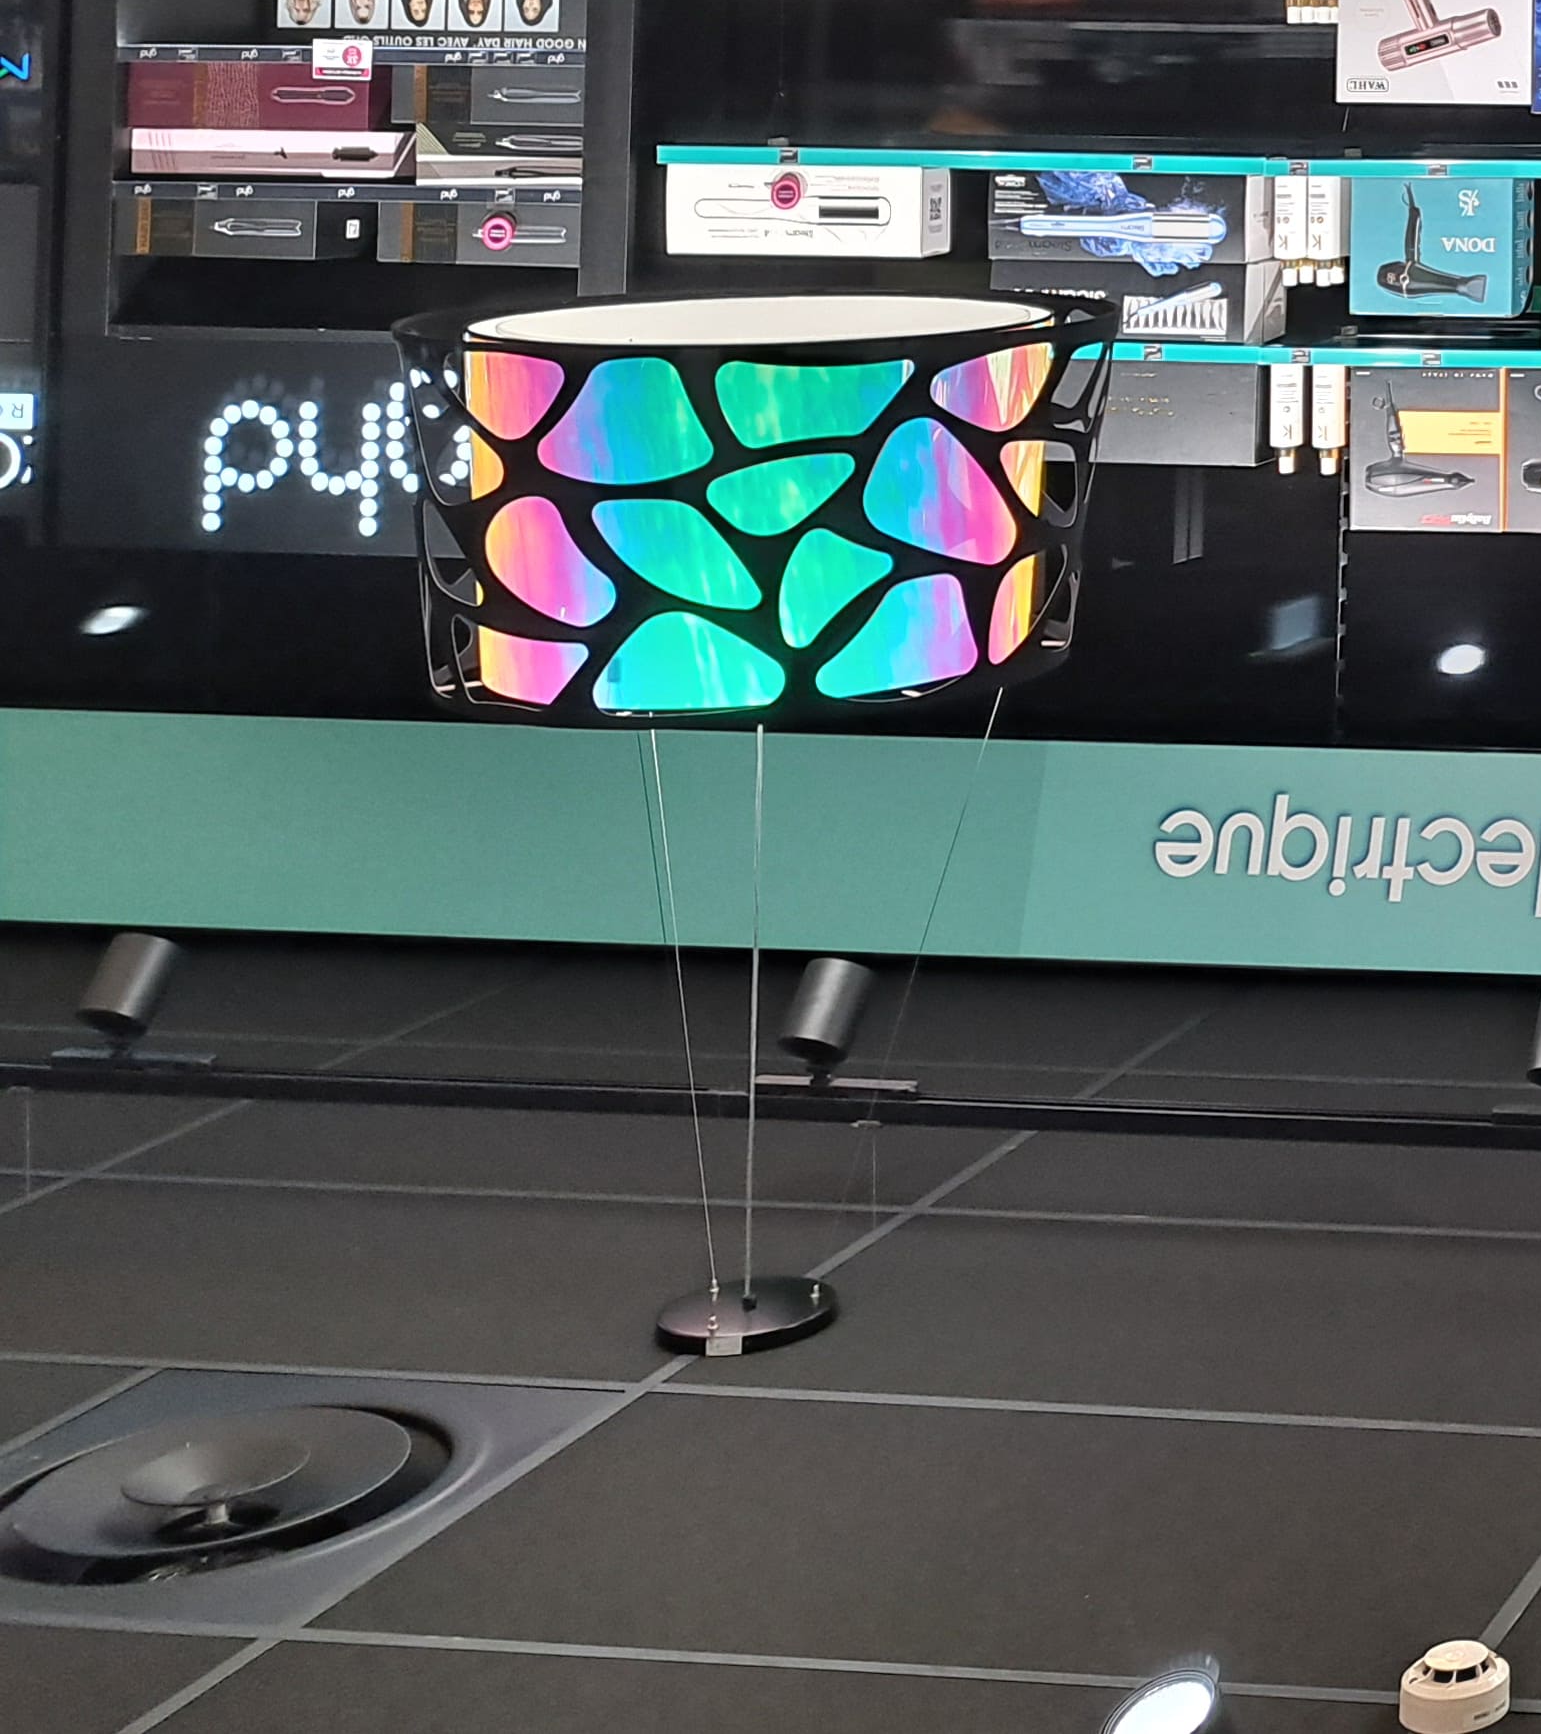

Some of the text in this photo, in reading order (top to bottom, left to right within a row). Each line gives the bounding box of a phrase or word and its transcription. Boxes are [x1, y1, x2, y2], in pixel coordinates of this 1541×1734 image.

[373, 35, 412, 47] OUTILS
[414, 35, 436, 47] LES
[439, 36, 469, 48] AVEC
[504, 37, 532, 49] HAIR
[535, 38, 574, 49] GOOD
[1348, 80, 1388, 91] WAHL
[134, 183, 151, 195] ghd
[236, 185, 253, 197] ghd
[338, 187, 355, 199] ghd
[440, 189, 457, 201] ghd
[544, 190, 561, 202] ghd
[1441, 236, 1495, 252] DONA
